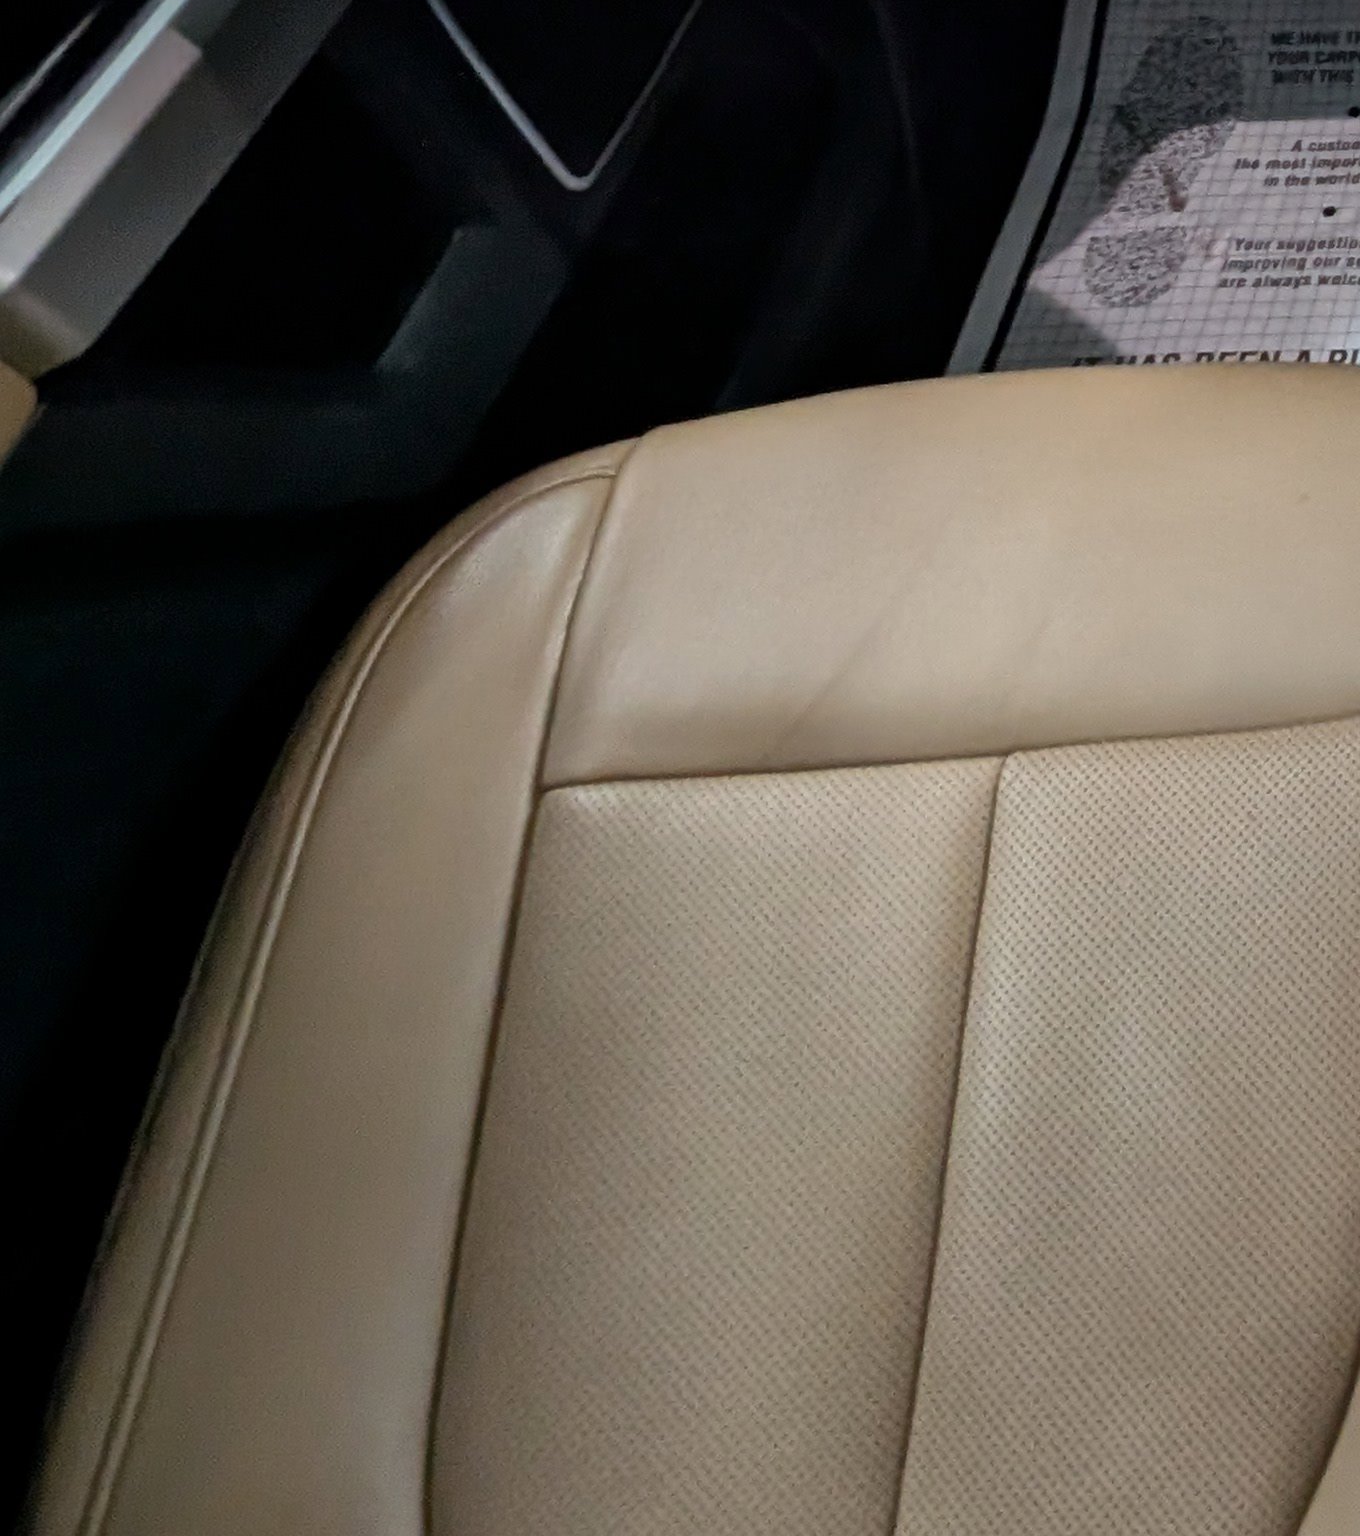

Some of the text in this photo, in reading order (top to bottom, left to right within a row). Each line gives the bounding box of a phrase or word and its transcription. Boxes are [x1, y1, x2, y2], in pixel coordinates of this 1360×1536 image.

[1271, 32, 1296, 45] WE
[1300, 31, 1341, 45] HAVE
[1269, 51, 1310, 64] YOUR
[1271, 69, 1316, 84] WITH
[1319, 69, 1354, 83] THIS
[1291, 139, 1303, 152] A
[1234, 158, 1260, 170] the
[1265, 158, 1306, 170] most
[1263, 175, 1280, 187] in
[1284, 174, 1311, 186] the
[1315, 173, 1360, 185] world
[1234, 238, 1272, 251] Your
[1223, 255, 1308, 272] improving
[1312, 256, 1342, 268] our
[1217, 277, 1247, 288] are
[1251, 275, 1312, 289] always
